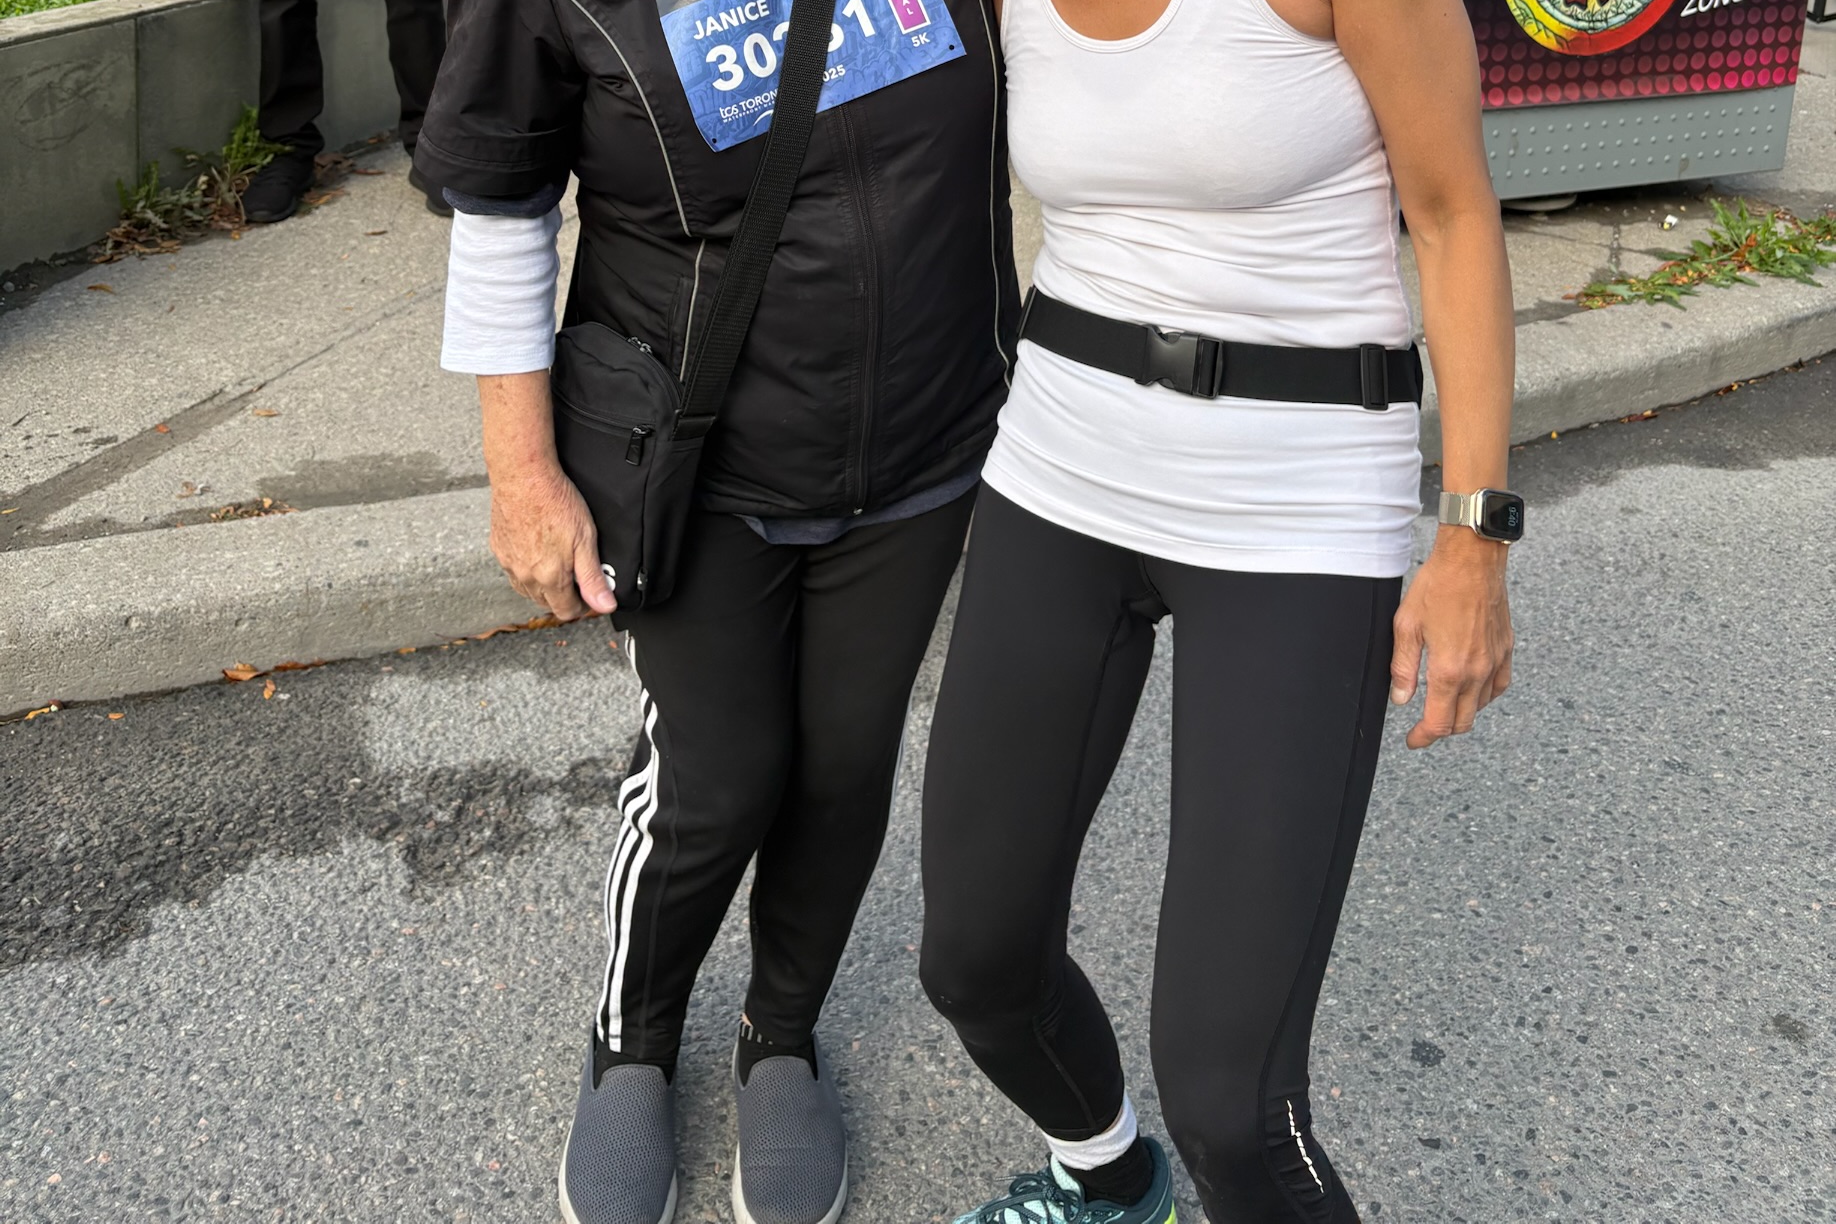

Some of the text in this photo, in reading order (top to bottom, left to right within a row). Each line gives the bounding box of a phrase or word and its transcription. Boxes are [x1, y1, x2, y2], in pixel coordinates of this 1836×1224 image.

[911, 32, 930, 48] 5K
[822, 64, 846, 82] 025
[719, 87, 778, 119] tcs TORON
